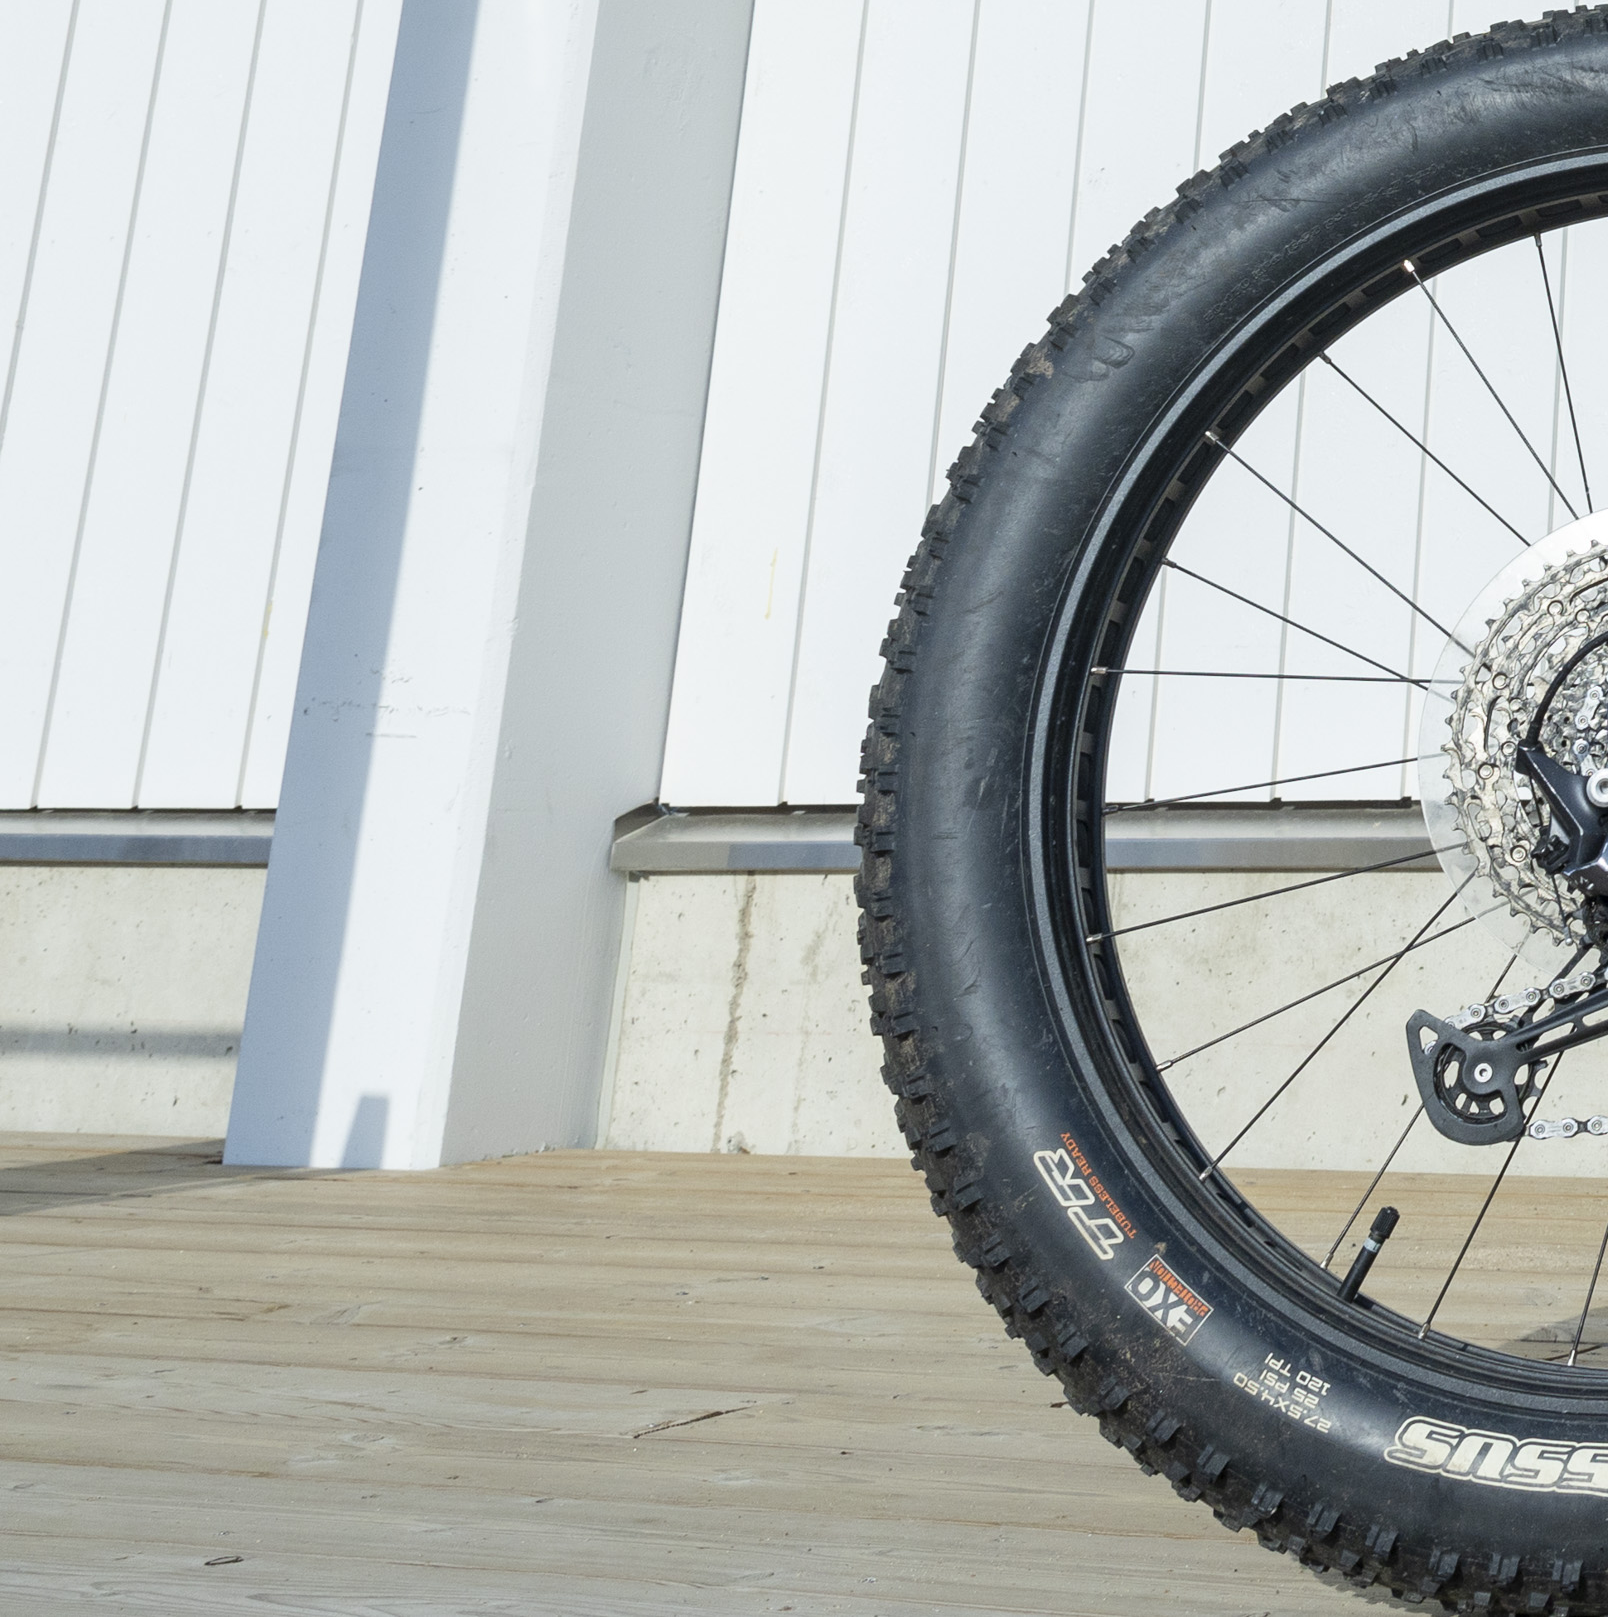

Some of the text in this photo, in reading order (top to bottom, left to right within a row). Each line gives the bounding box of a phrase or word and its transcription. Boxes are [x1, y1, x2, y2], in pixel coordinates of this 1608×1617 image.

[1061, 1132, 1137, 1239] TUBELESS READY
[1126, 1266, 1203, 1341] EXO
[1260, 1370, 1319, 1409] 25 PSI
[1264, 1352, 1331, 1396] 120 TPI
